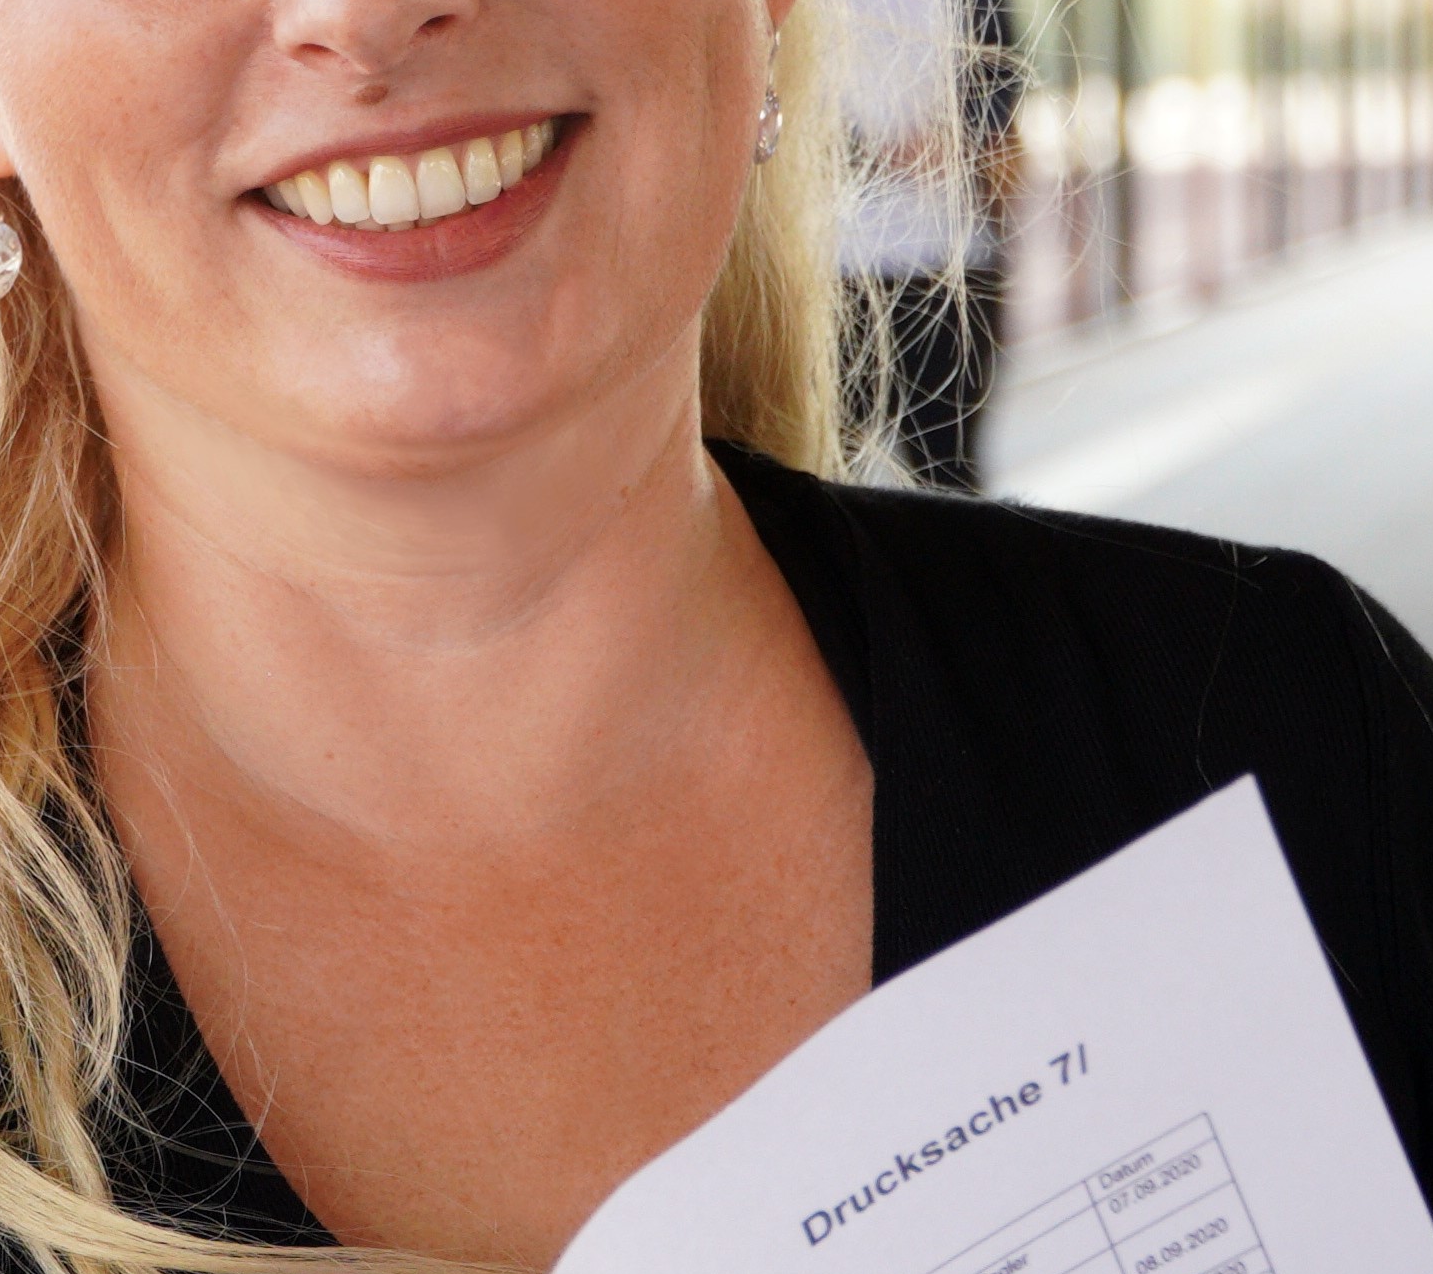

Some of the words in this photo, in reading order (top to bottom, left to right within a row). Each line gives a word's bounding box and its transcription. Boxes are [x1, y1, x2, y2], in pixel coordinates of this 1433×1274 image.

[800, 1080, 1043, 1247] Drucksache
[1048, 1042, 1088, 1085] 7/
[1098, 1153, 1154, 1189] Datum
[1109, 1153, 1201, 1214] 07.09.2020
